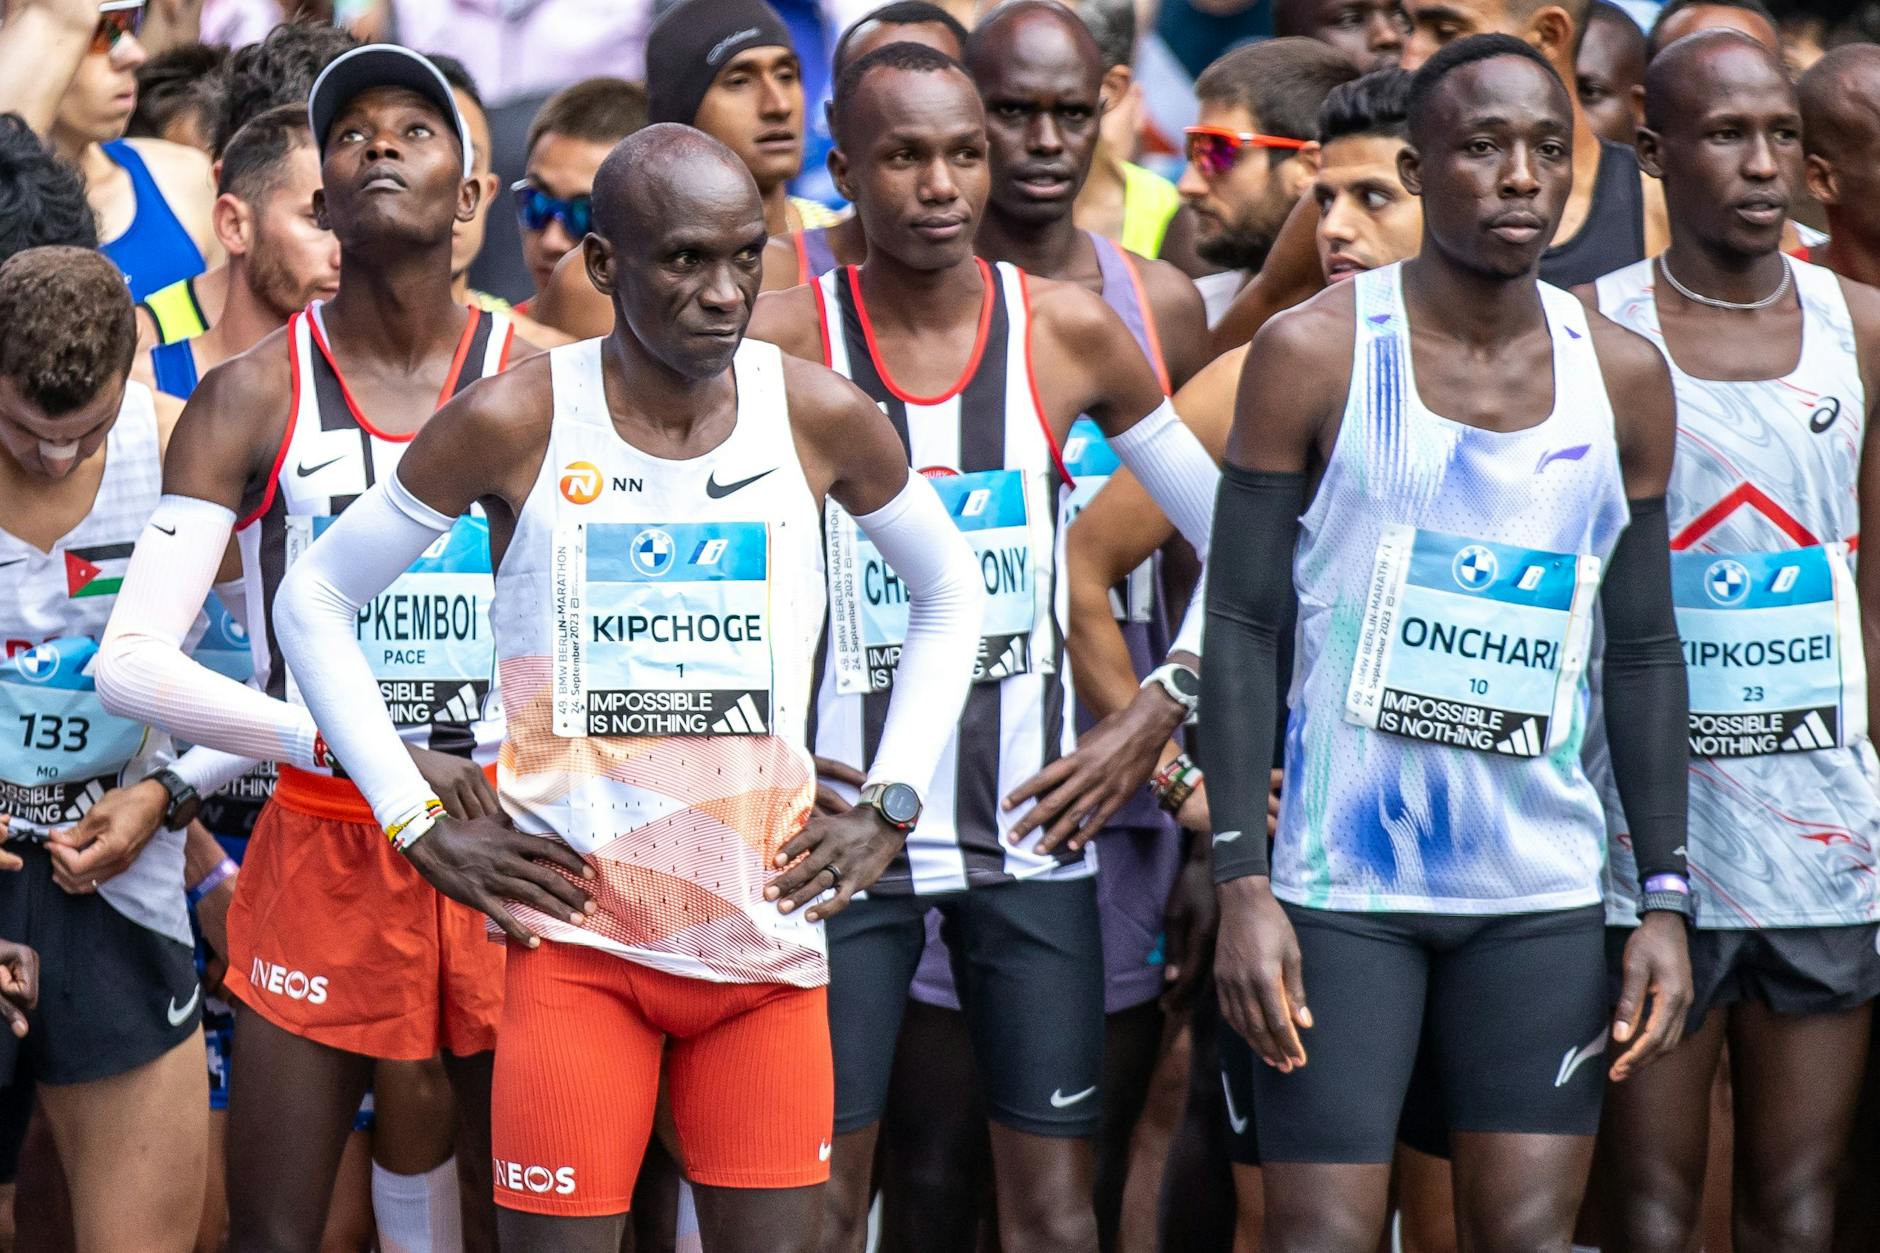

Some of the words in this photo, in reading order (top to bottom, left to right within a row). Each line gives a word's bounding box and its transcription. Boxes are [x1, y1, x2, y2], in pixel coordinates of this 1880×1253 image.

[612, 477, 643, 492] NN
[830, 509, 846, 626] BERLIN-MARATHON
[865, 546, 1027, 605] CHONY
[844, 573, 853, 598] 2023
[357, 593, 477, 641] PKEMBOI
[557, 546, 567, 665] BERLIN-MARATHON
[570, 613, 579, 638] 2023
[593, 614, 762, 642] KIPCHOGE
[848, 598, 860, 653] September
[839, 626, 848, 653] BMW
[1368, 635, 1387, 690] September
[1379, 611, 1392, 634] 2023
[1401, 616, 1559, 670] ONCHARI
[384, 649, 426, 664] PACE
[571, 638, 582, 695] September
[558, 666, 568, 694] BMW
[676, 663, 684, 678] 1
[380, 682, 435, 702] SIBLE
[1469, 678, 1489, 695] 10
[1742, 686, 1765, 702] 23
[558, 699, 567, 716] 49.
[589, 692, 712, 712] IMPOSSIBLE
[1383, 691, 1504, 730] IMPOSSIBLE
[19, 712, 91, 752] 133
[590, 714, 609, 733] IS
[612, 714, 708, 733] NOTHING
[1379, 711, 1399, 731] IS
[1401, 717, 1494, 750] NOTHING
[1689, 735, 1779, 756] NOTHING
[36, 765, 58, 778] MO
[250, 956, 329, 1005] INEOS
